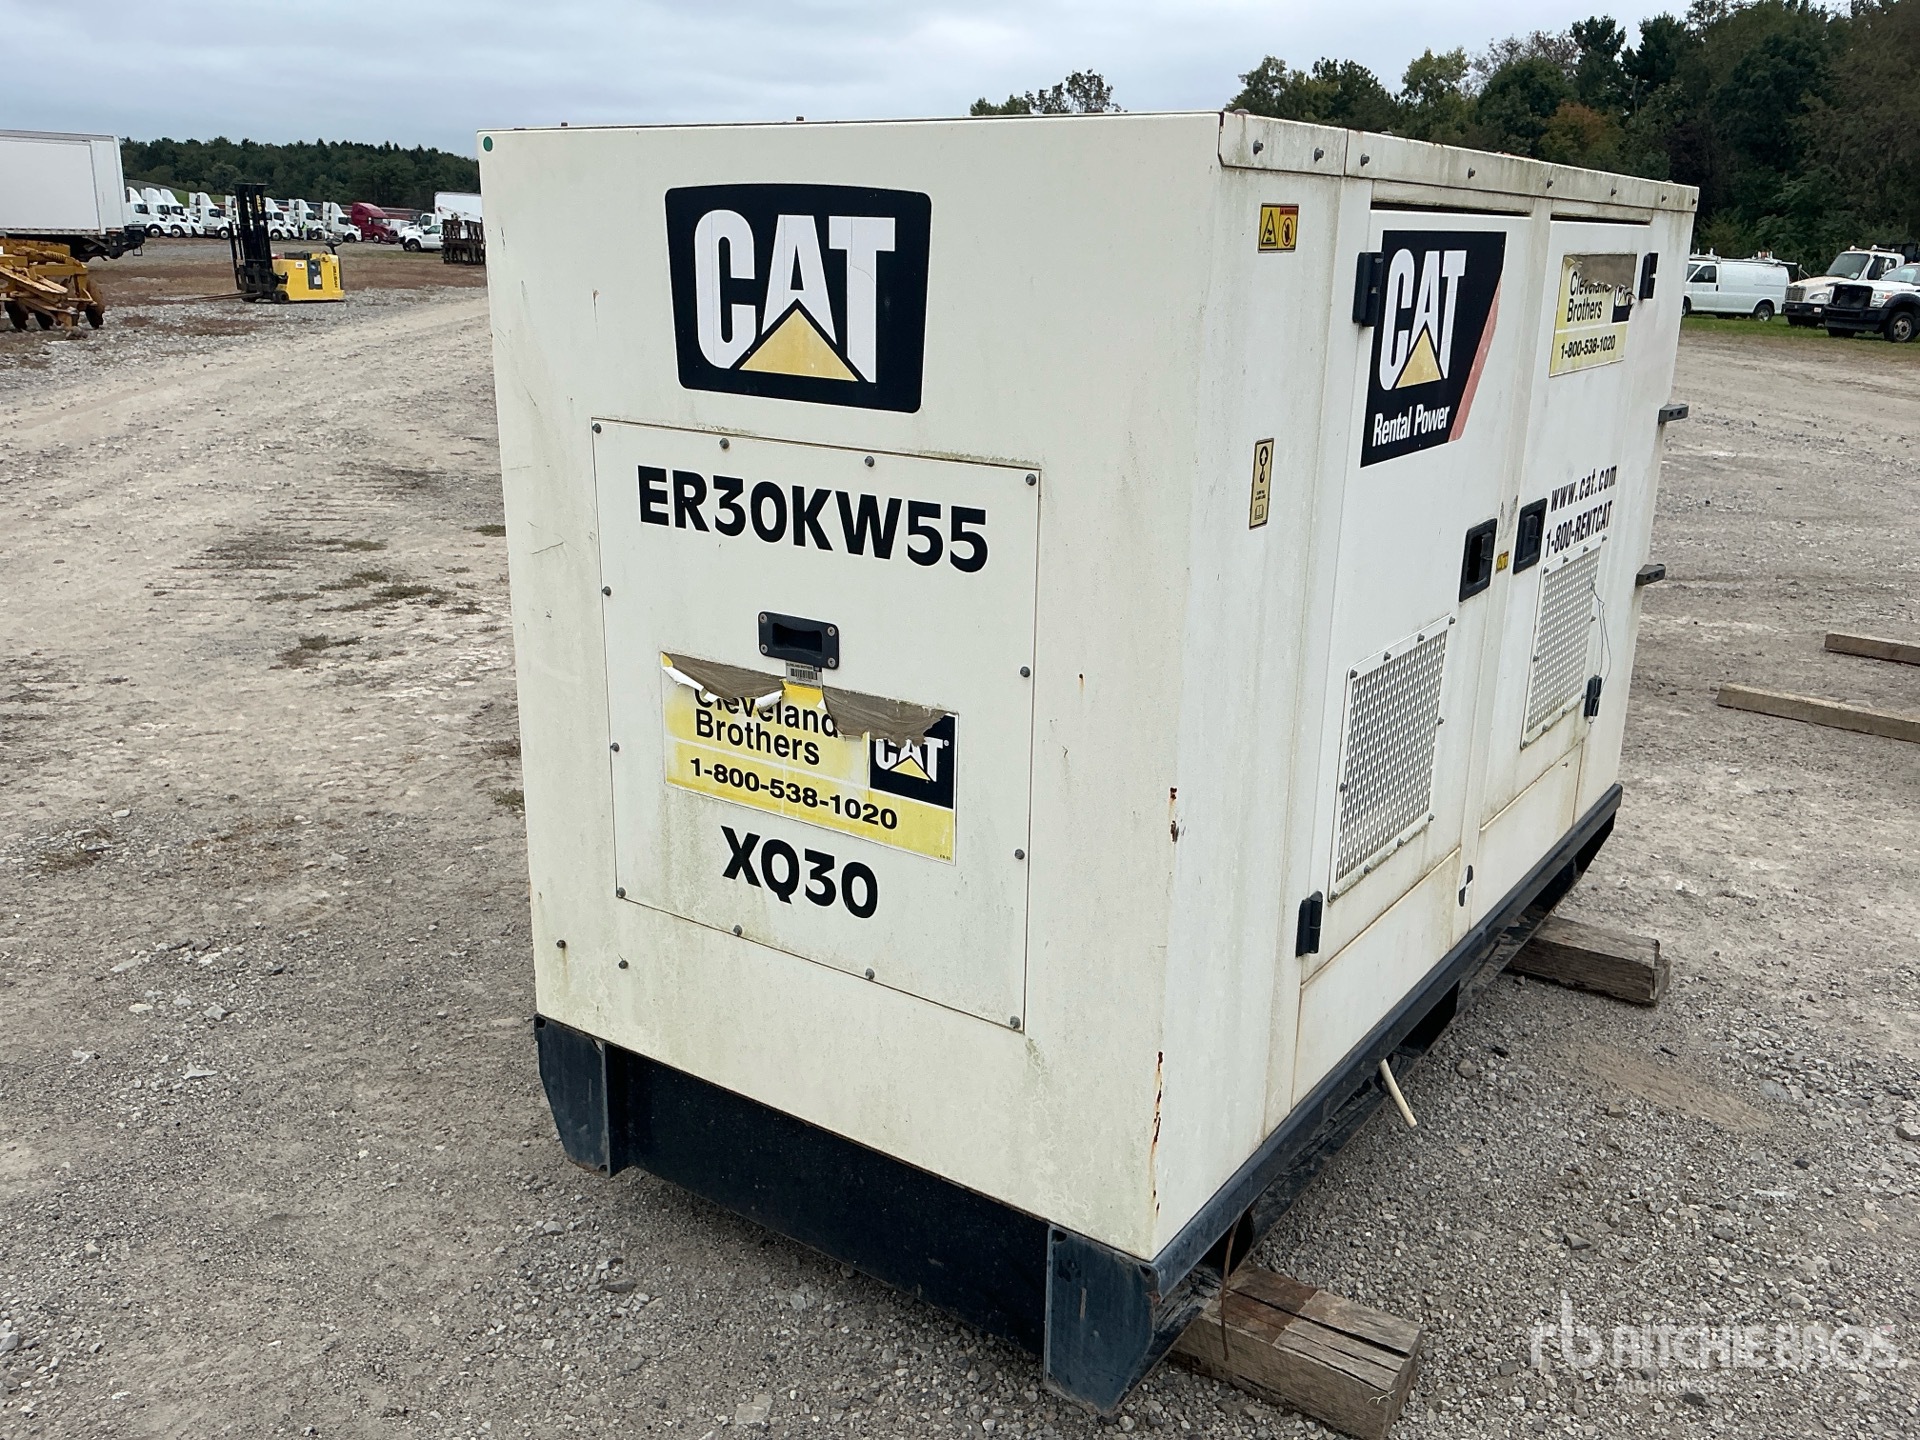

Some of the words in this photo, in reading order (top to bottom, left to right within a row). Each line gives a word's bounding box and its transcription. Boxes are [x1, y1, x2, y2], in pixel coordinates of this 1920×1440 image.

[694, 209, 896, 383] CAT
[1379, 248, 1467, 391] CAT
[1567, 297, 1603, 323] Brothers
[1561, 334, 1616, 360] 1-800-538-1020
[1372, 405, 1413, 447] Rental
[1413, 403, 1450, 436] Power
[1551, 465, 1617, 512] www.cat.com
[637, 465, 988, 573] ER30KW55
[1546, 499, 1613, 558] 1-800-RENTCAT
[695, 708, 820, 766] Brothers
[690, 758, 897, 830] 1-800-538-1020
[721, 825, 878, 919] XQ30
